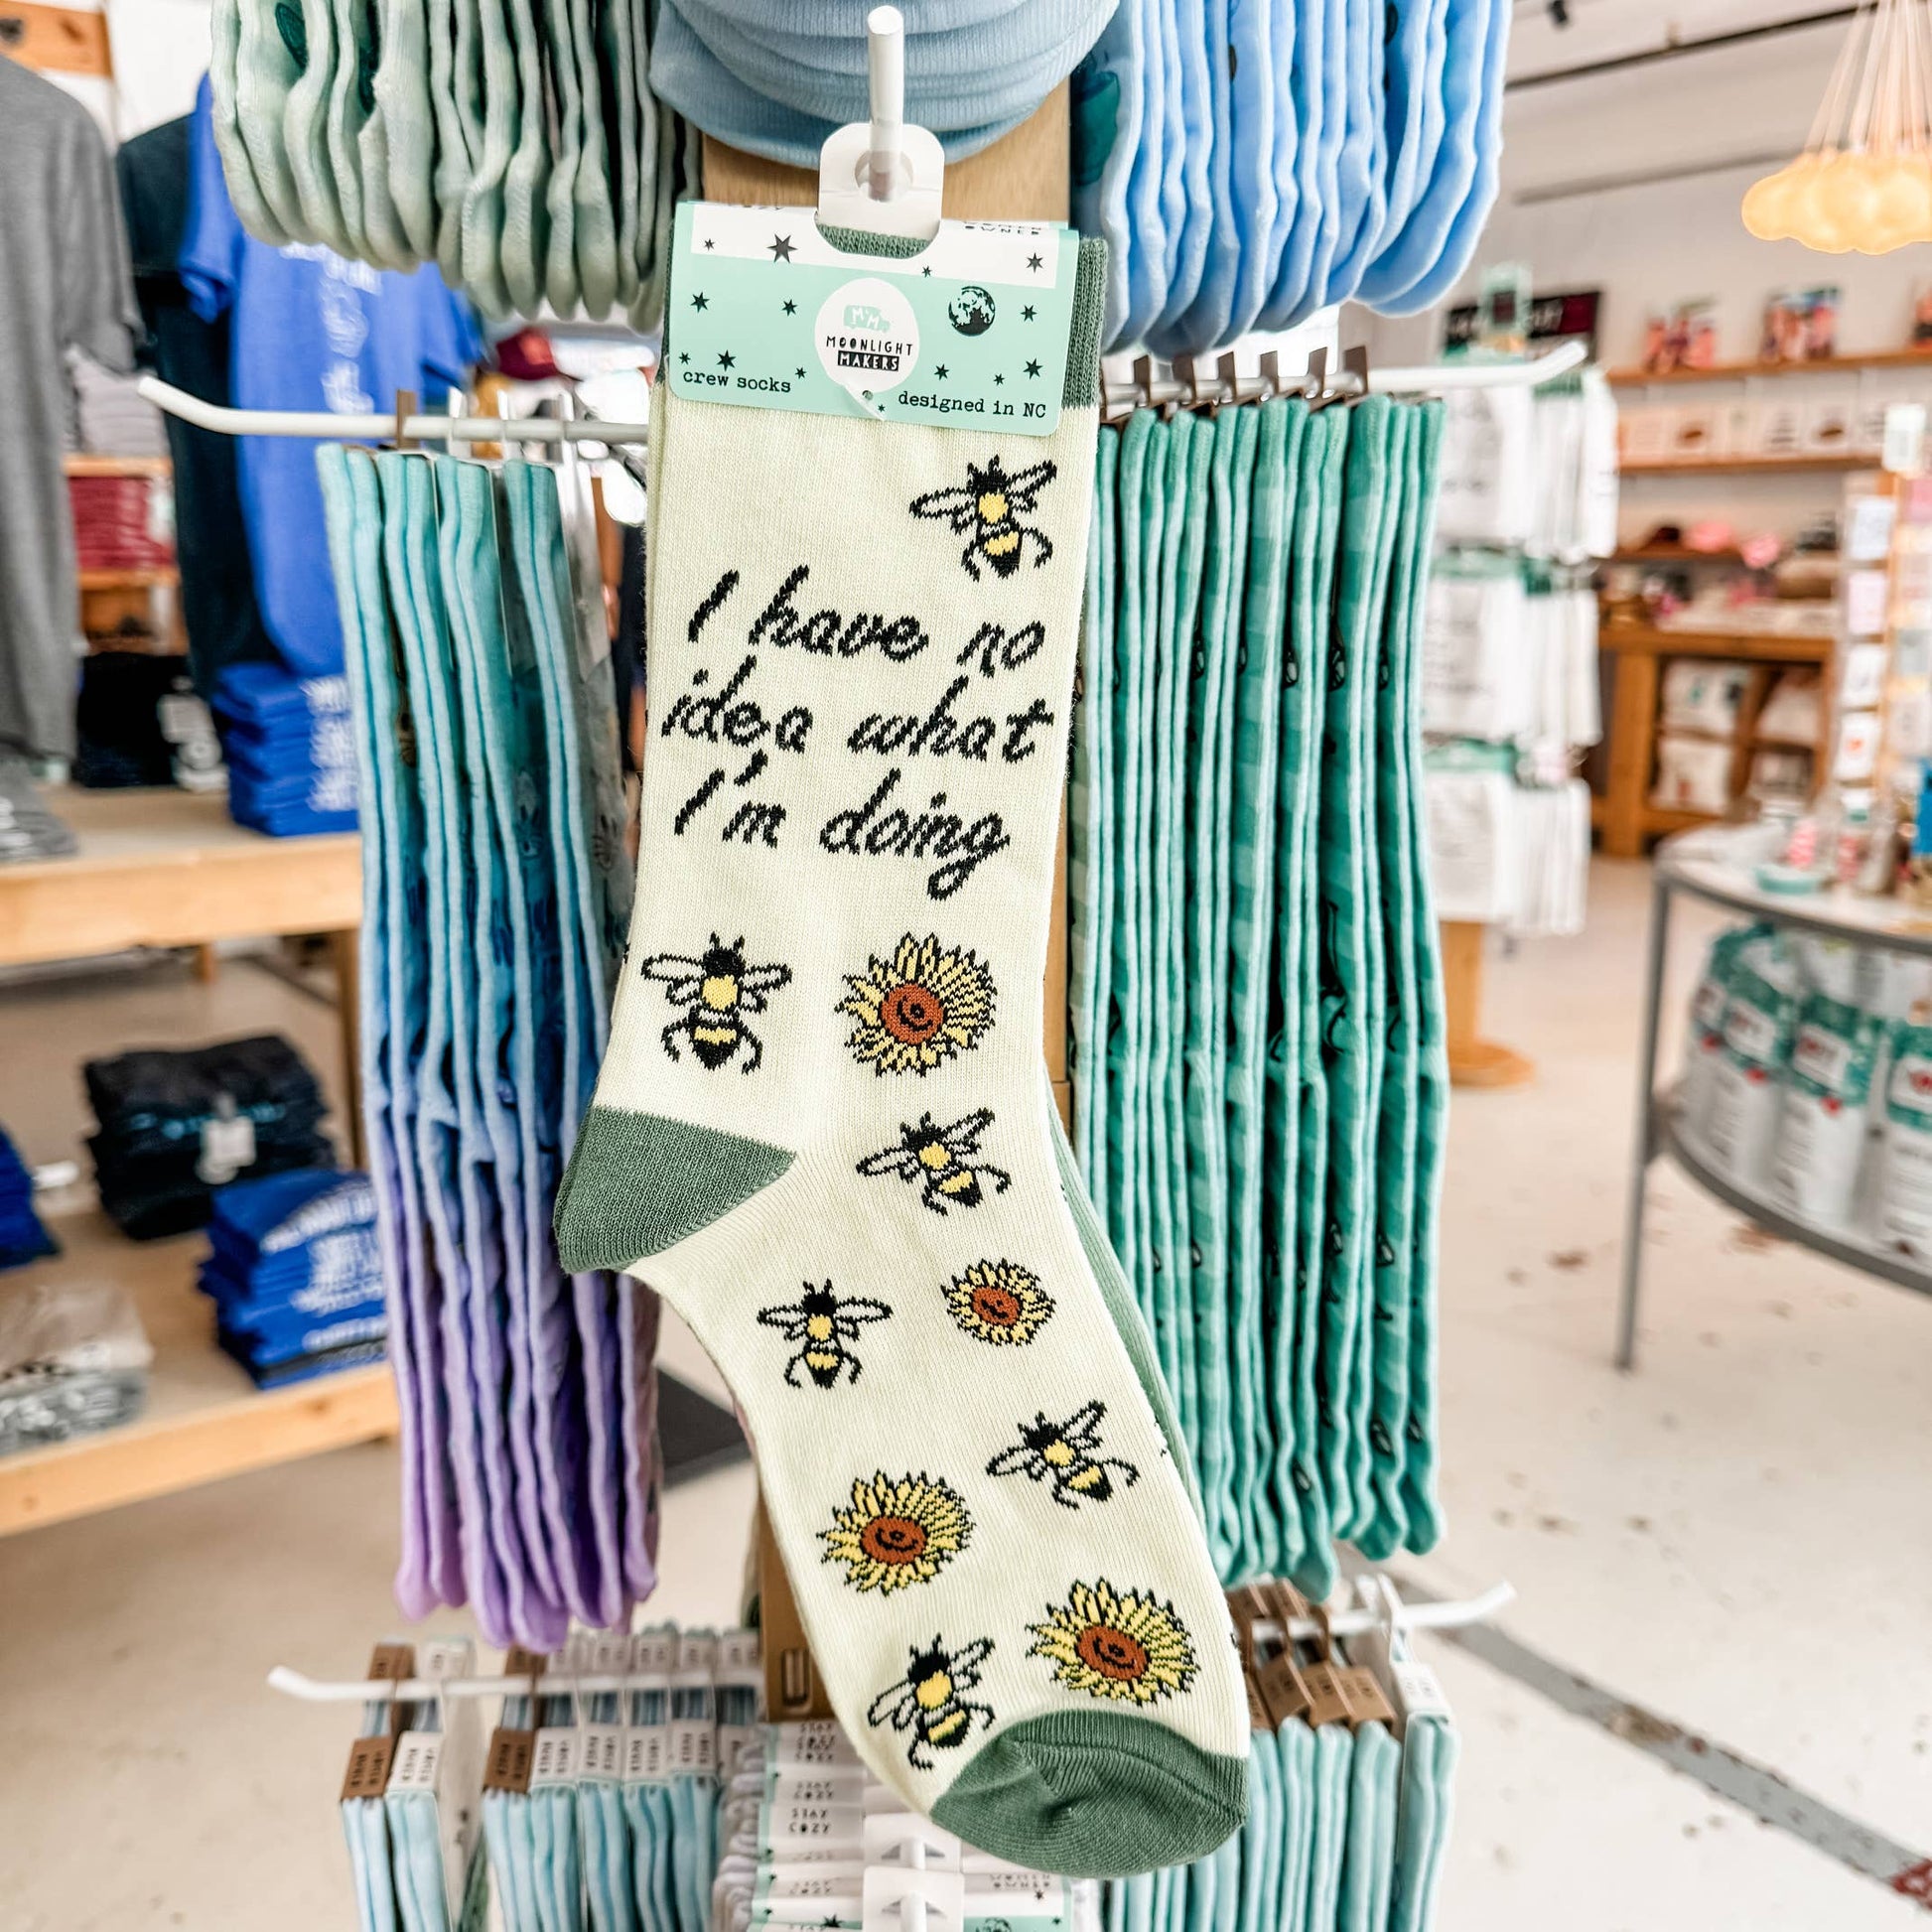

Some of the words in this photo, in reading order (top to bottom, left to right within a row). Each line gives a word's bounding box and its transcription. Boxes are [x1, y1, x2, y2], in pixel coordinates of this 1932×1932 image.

[826, 335, 913, 356] MOONLIGHT
[838, 350, 899, 371] MAKERS
[683, 371, 729, 387] crew
[737, 376, 791, 393] socks
[897, 390, 985, 414] designed
[993, 400, 1015, 416] in
[1023, 402, 1046, 419] NC
[688, 569, 740, 643] I
[749, 565, 929, 663] have
[956, 620, 1045, 677] no
[661, 654, 813, 755] idea
[847, 674, 1054, 763] what
[674, 749, 787, 849] I'm
[819, 767, 1011, 901] doing
[791, 1807, 829, 1819] STAY
[788, 1821, 830, 1835] COZY
